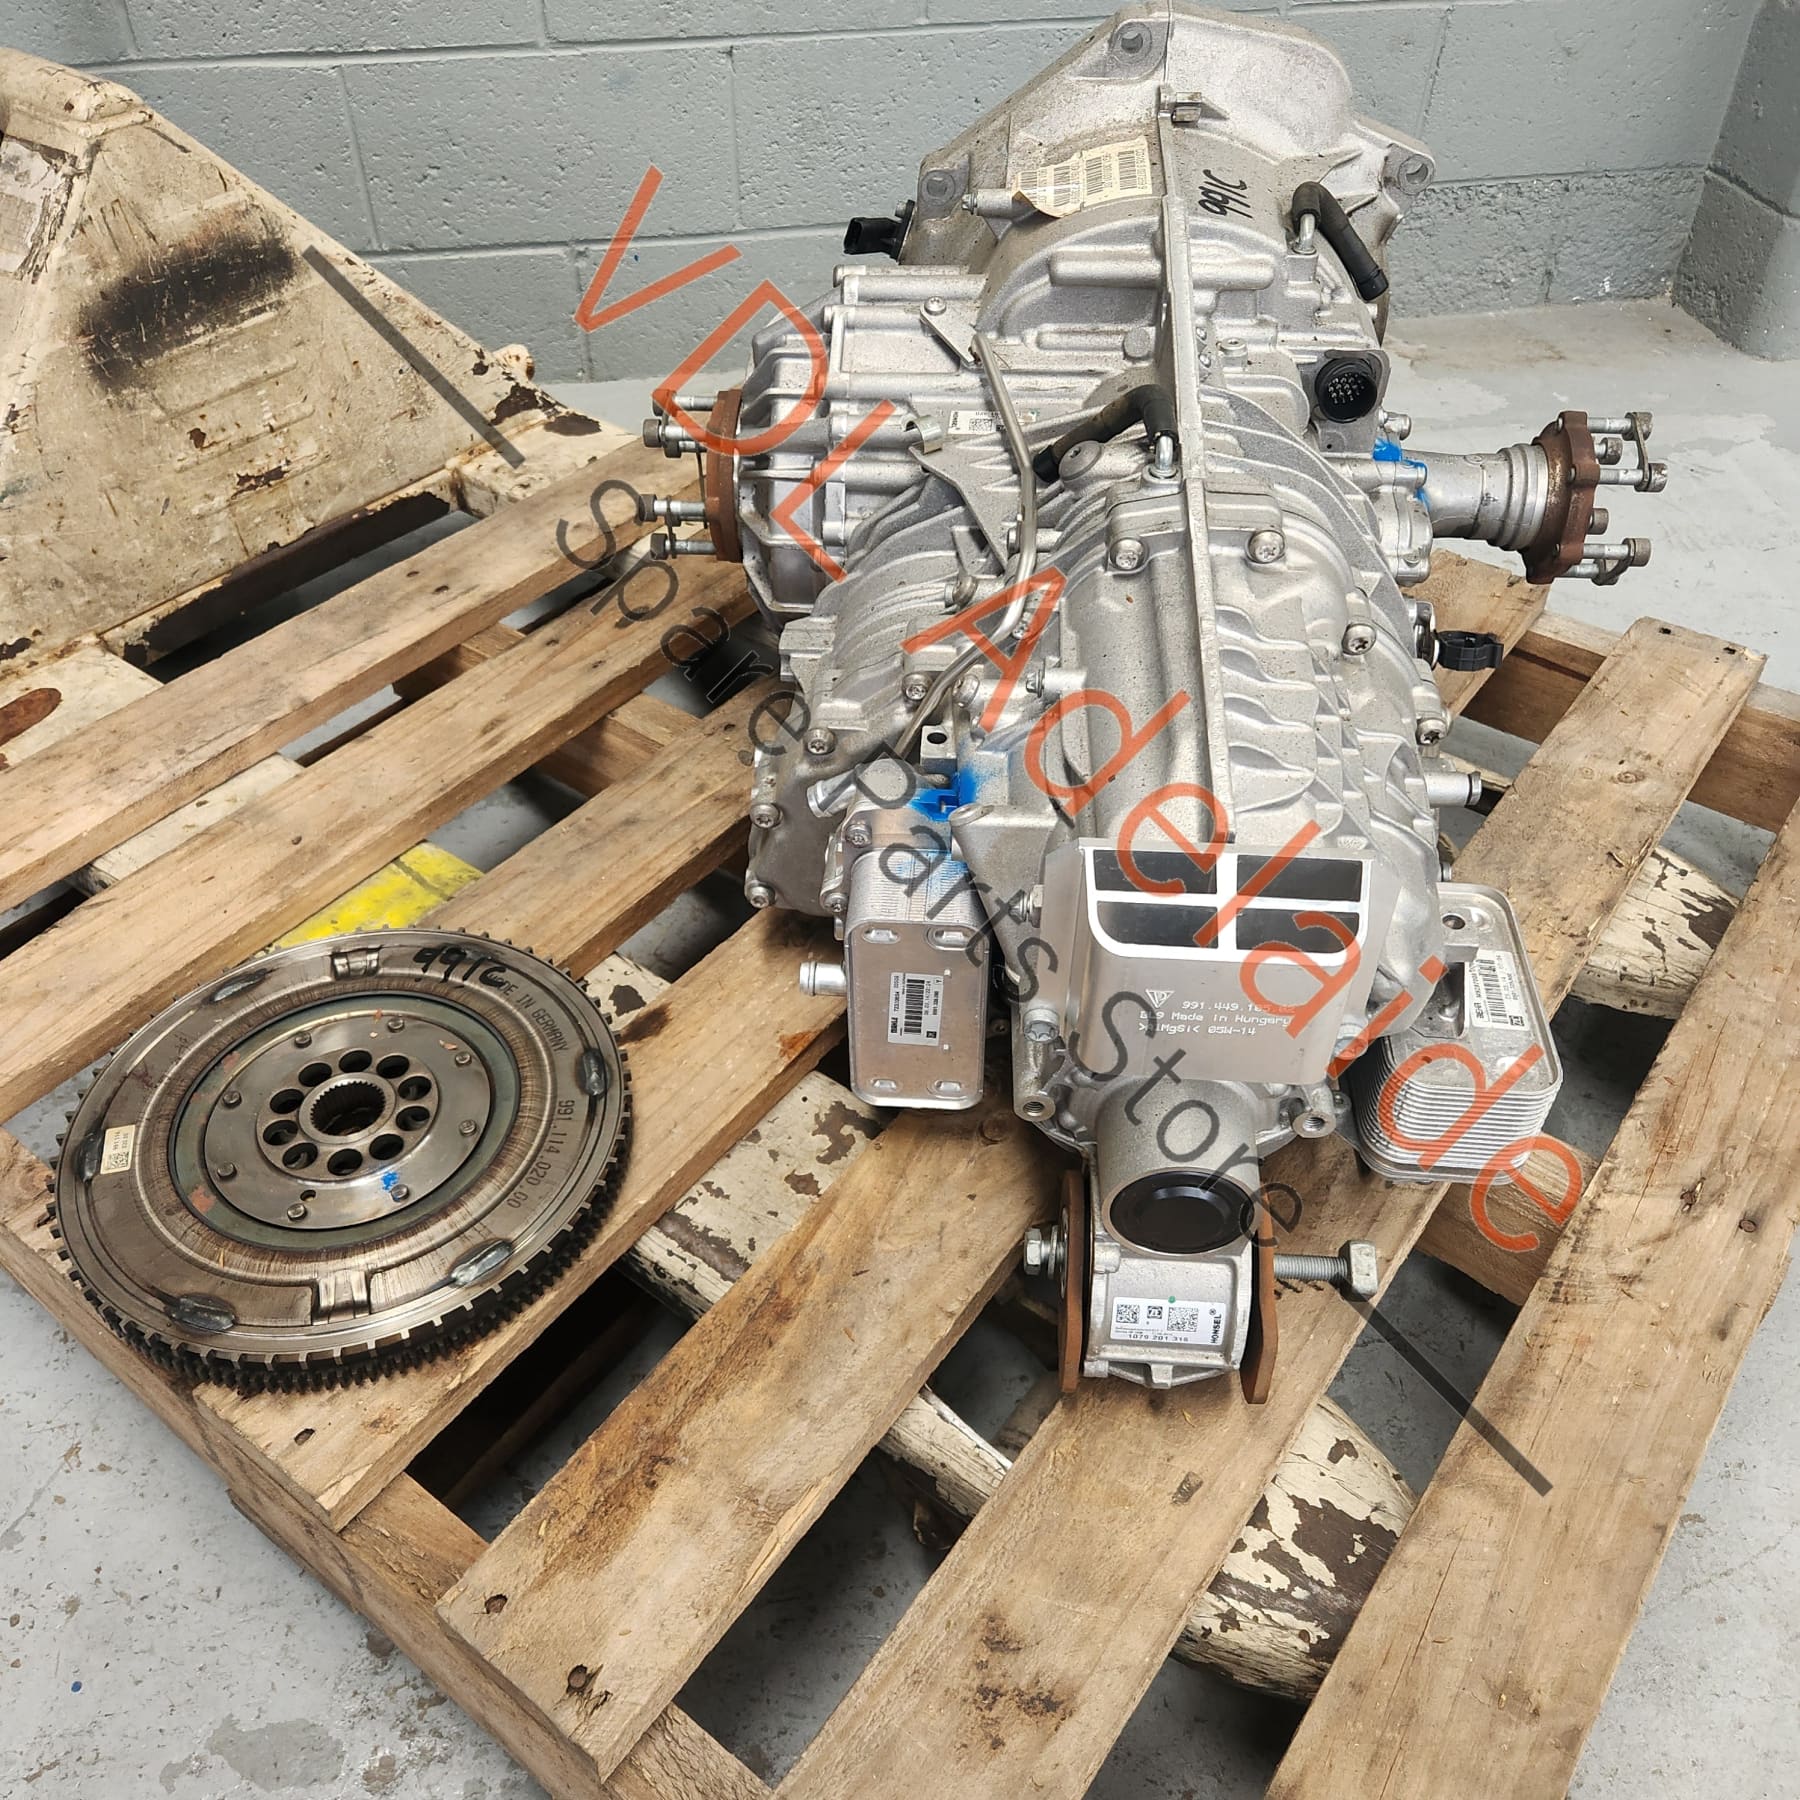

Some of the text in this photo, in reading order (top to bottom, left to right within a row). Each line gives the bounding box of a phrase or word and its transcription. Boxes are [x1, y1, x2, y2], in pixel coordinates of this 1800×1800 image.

[413, 942, 507, 988] 991C
[517, 993, 534, 1009] IN
[531, 1007, 571, 1053] GERMANY
[1171, 1011, 1204, 1021] Made
[1213, 1012, 1227, 1022] in
[1210, 1314, 1222, 1344] HONSEL
